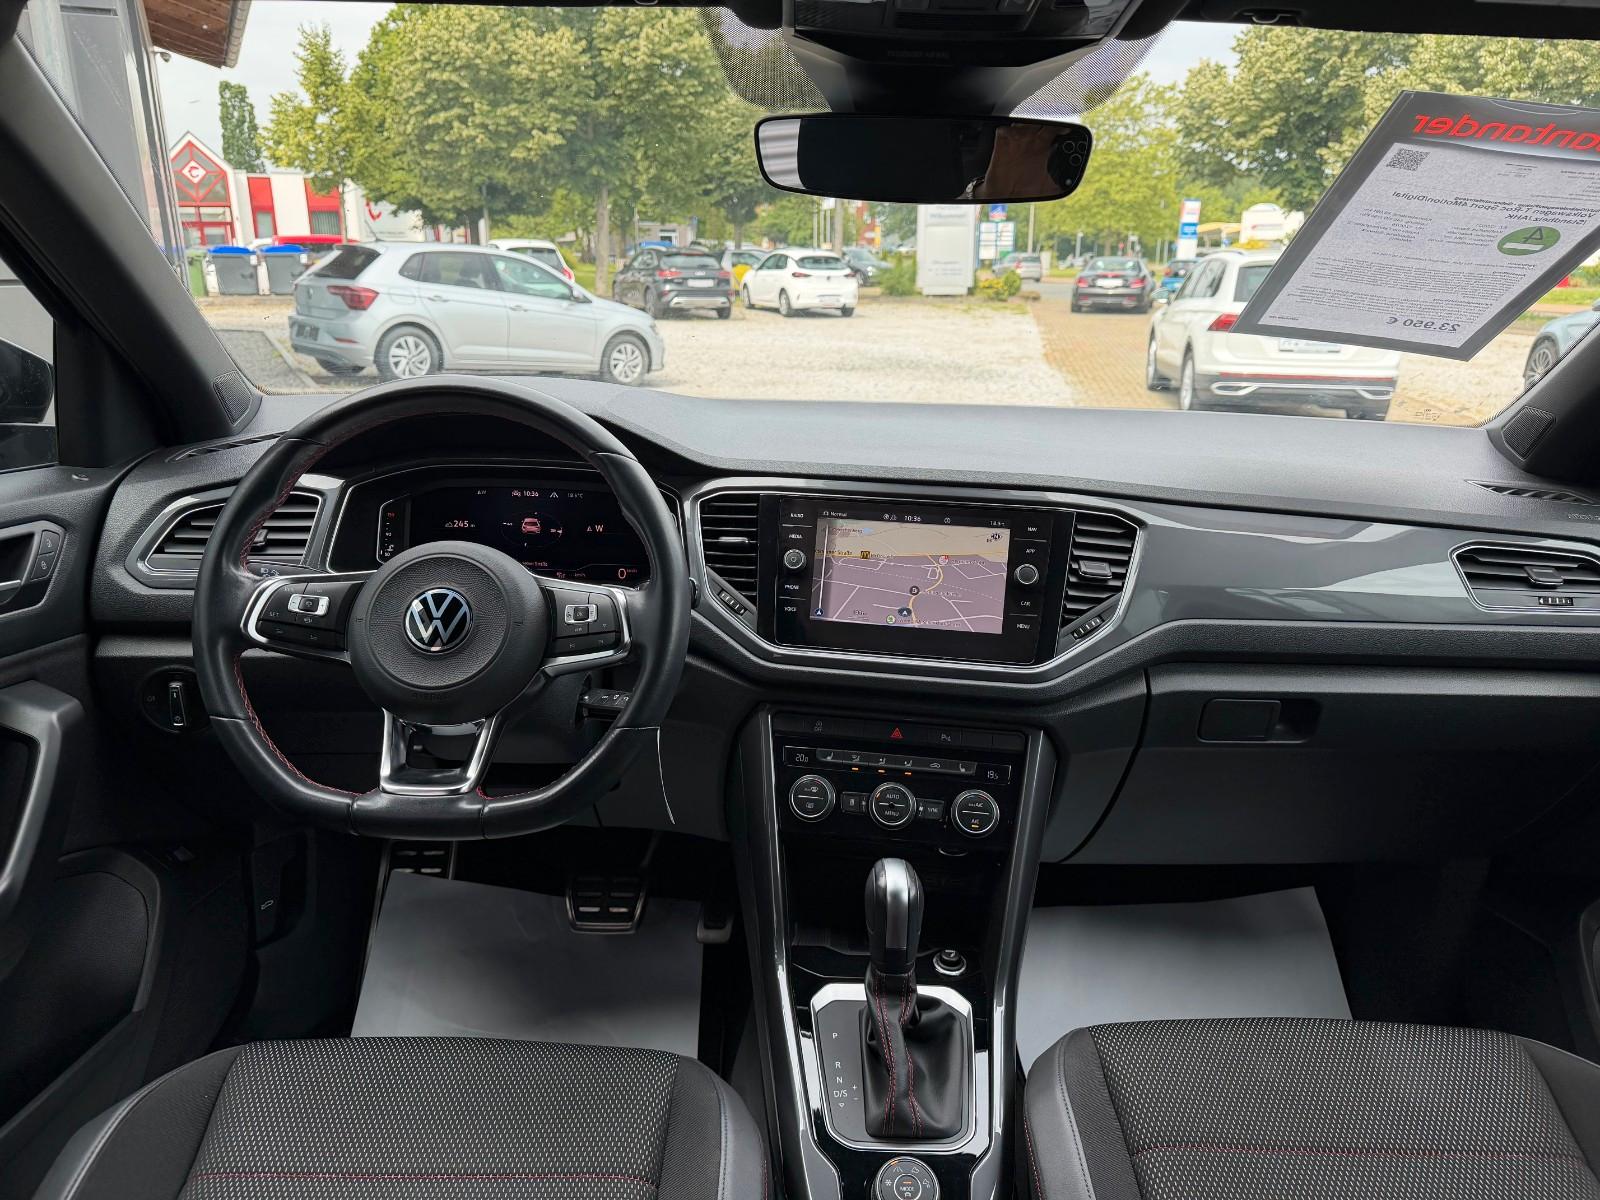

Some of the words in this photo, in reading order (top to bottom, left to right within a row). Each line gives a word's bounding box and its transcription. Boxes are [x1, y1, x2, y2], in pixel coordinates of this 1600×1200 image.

[453, 519, 469, 528] 245
[618, 568, 627, 579] 0
[835, 1061, 841, 1069] R
[836, 1076, 843, 1084] N
[833, 1089, 848, 1098] D/S
